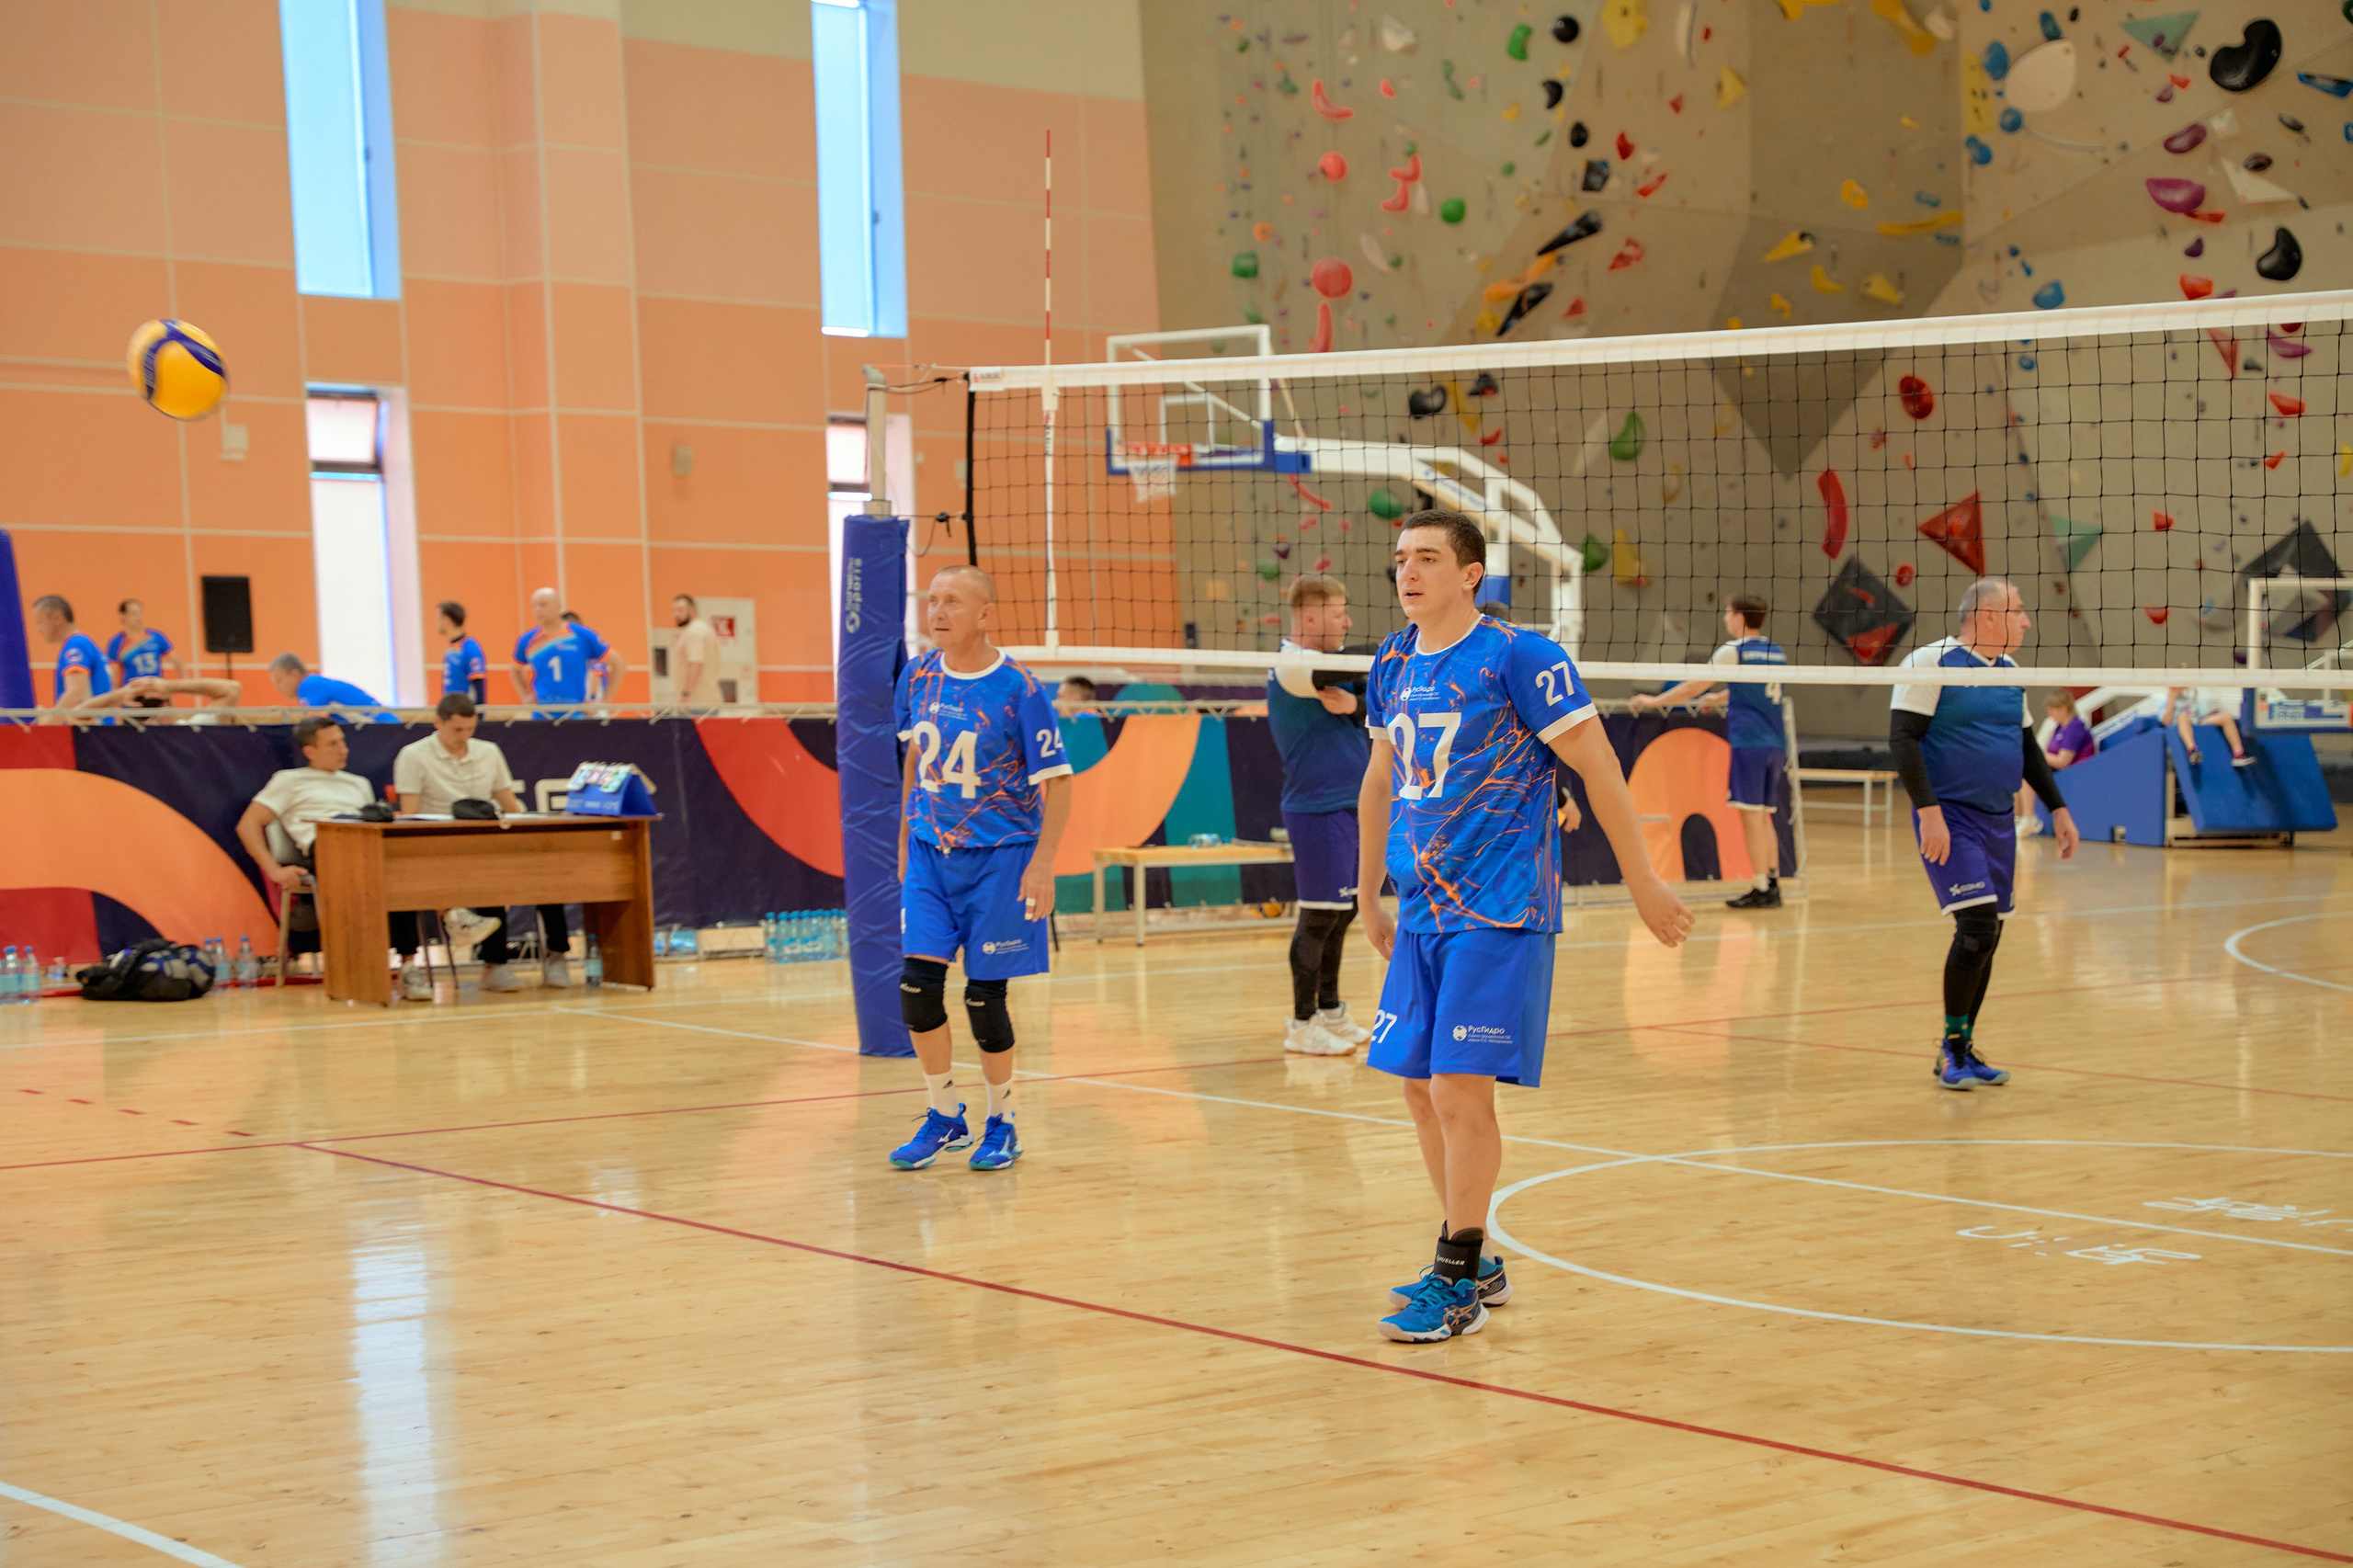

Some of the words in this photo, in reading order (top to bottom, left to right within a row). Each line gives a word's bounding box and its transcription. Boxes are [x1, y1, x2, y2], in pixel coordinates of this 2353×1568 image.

[548, 655, 562, 682] 1
[1535, 660, 1575, 707] 27
[913, 721, 982, 799] 24
[1387, 711, 1461, 801] 27
[1467, 1025, 1506, 1035] РусГидро
